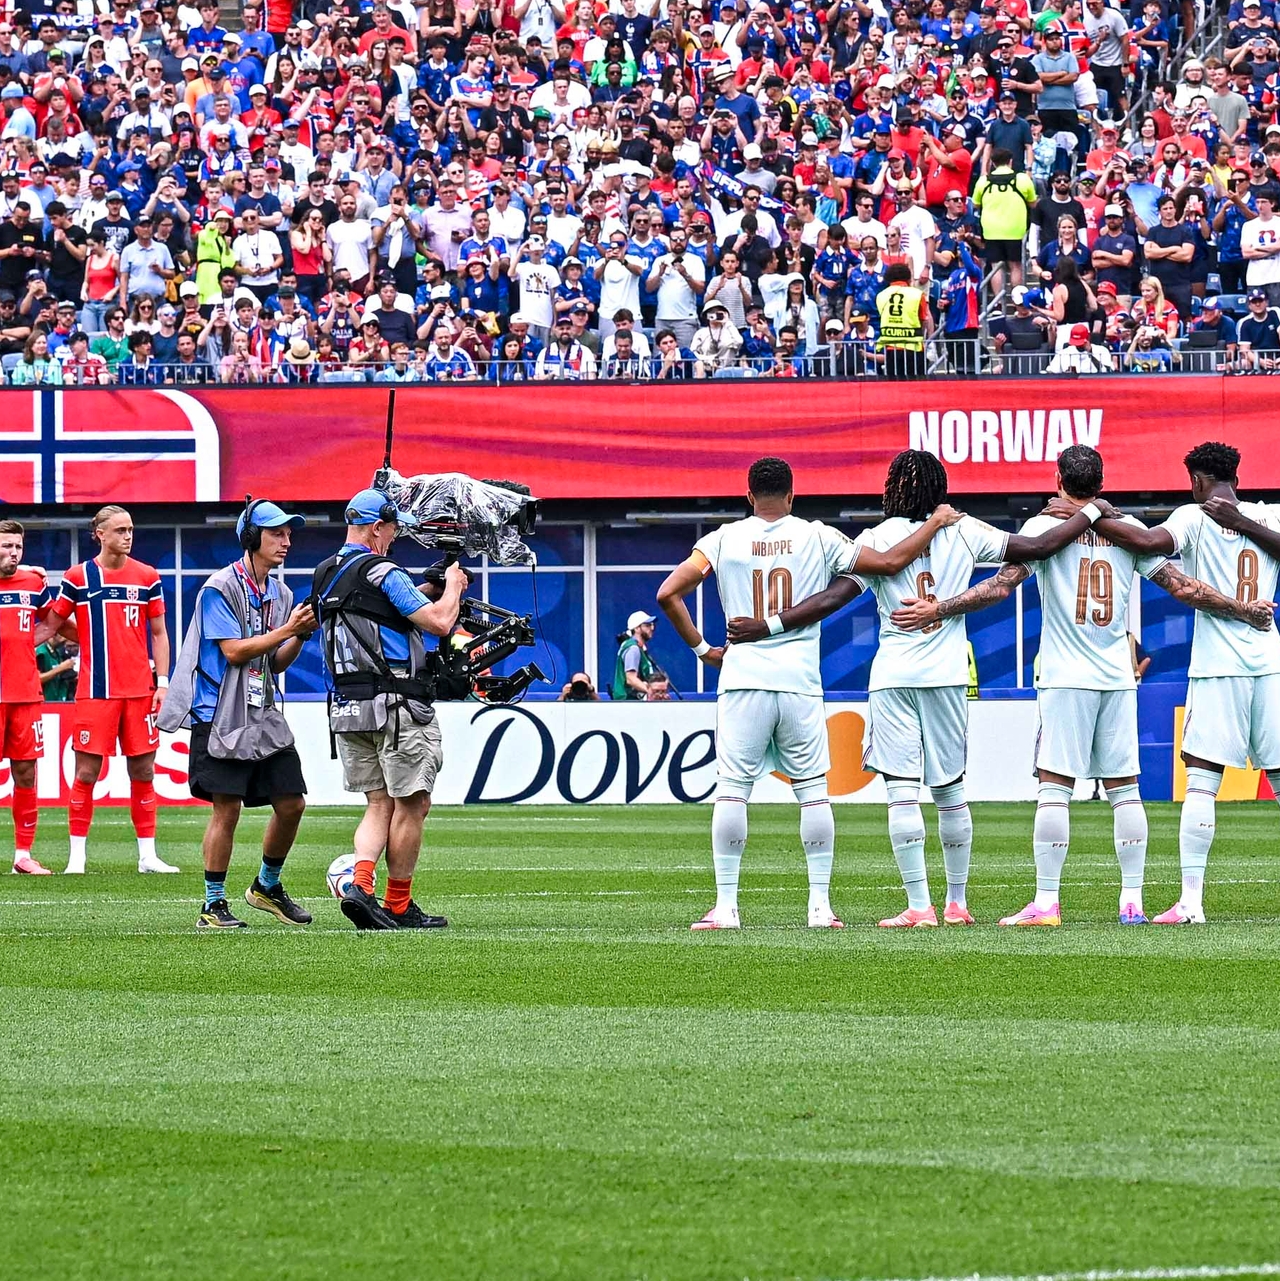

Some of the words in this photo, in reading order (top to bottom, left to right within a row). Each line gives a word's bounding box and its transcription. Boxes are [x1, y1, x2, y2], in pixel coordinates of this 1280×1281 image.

[909, 408, 1104, 463] NORWAY
[752, 539, 793, 558] MBAPPE
[1236, 548, 1258, 603] 8
[123, 605, 139, 627] 19
[752, 567, 793, 621] 10
[1075, 557, 1113, 627] 19
[17, 609, 31, 632] 15
[464, 705, 717, 804] Dove
